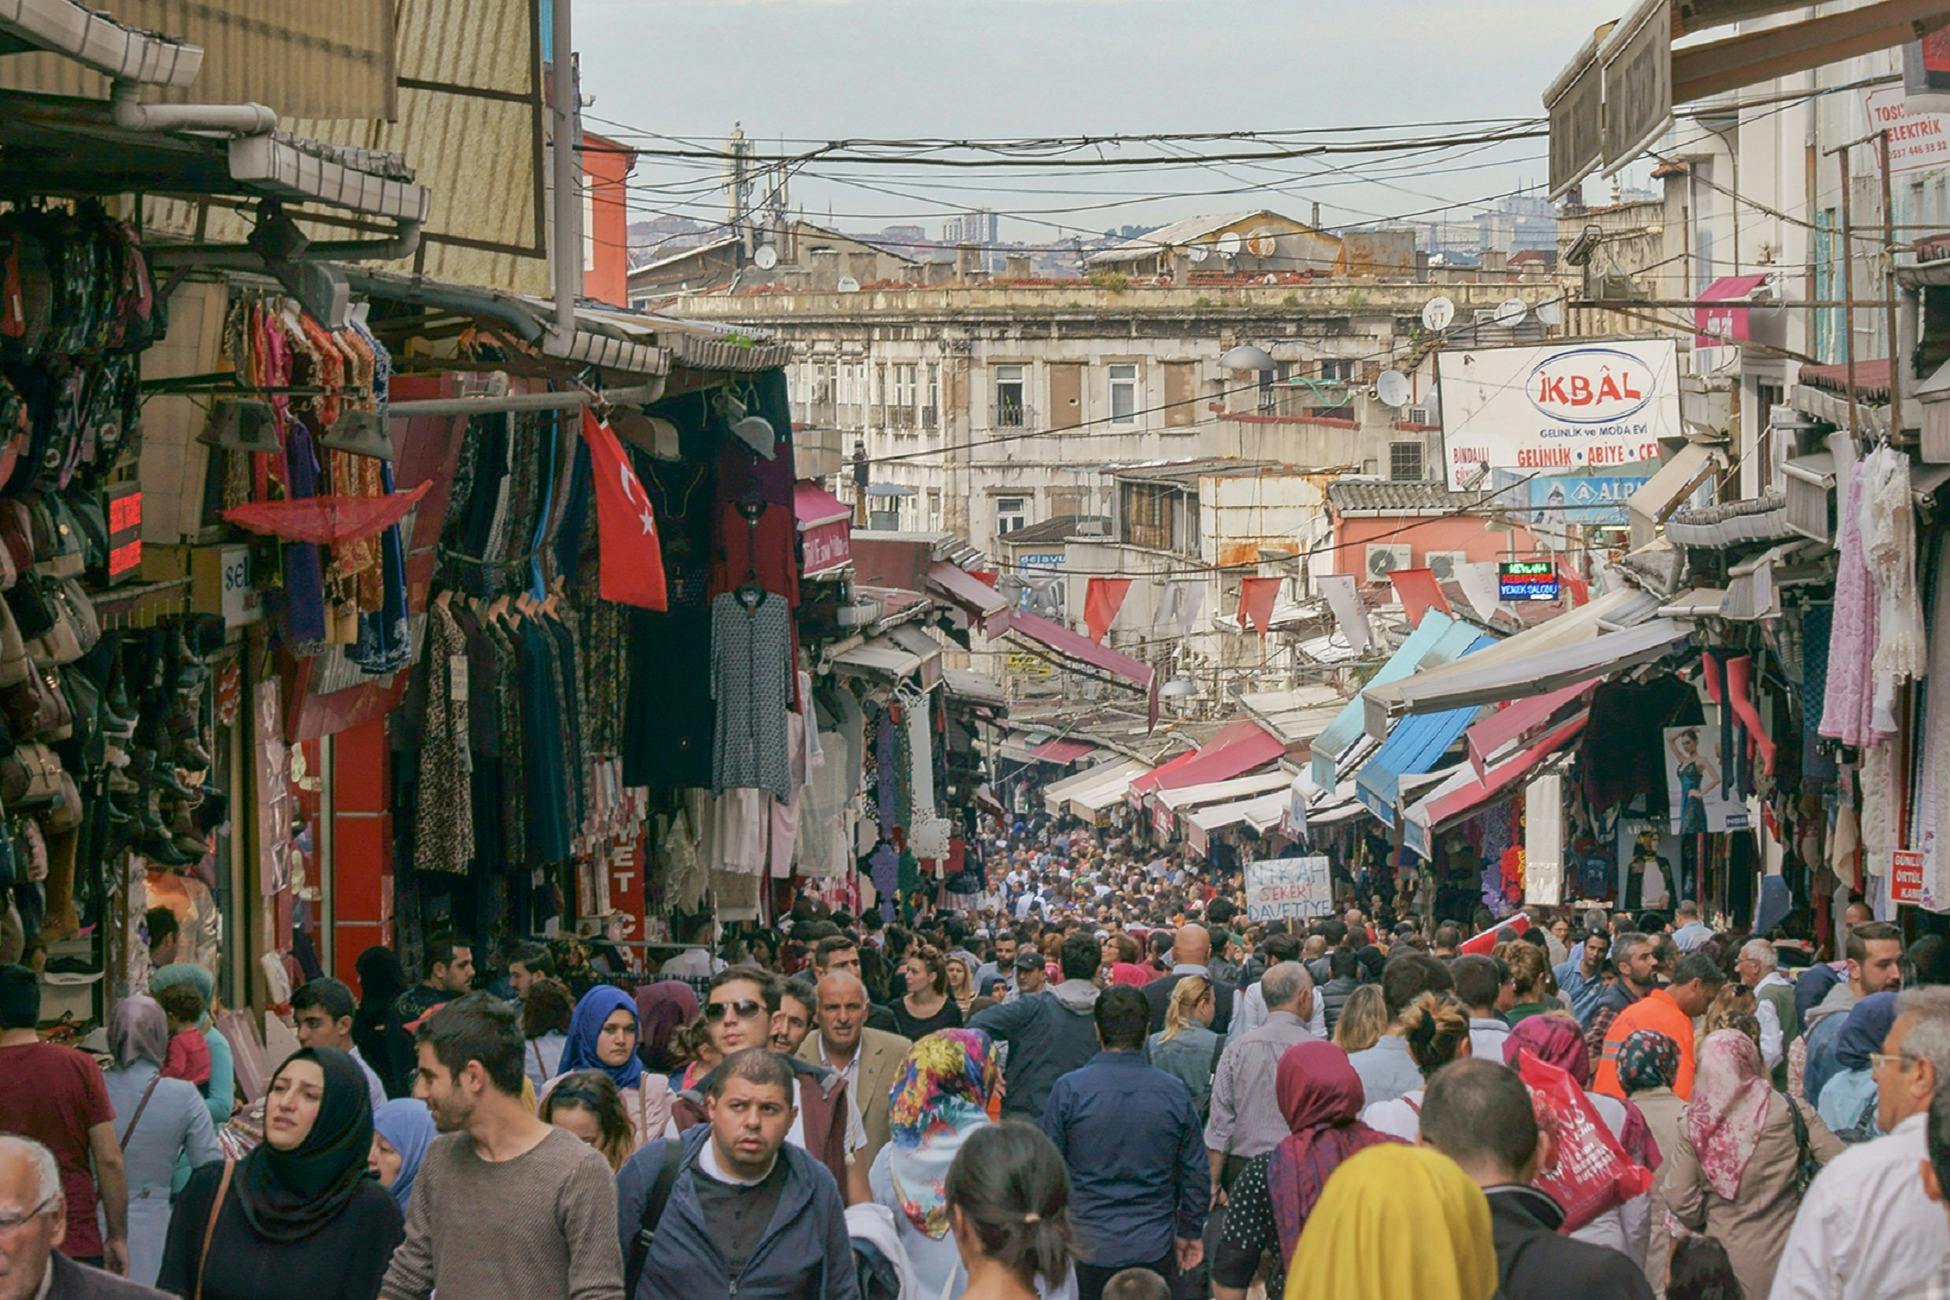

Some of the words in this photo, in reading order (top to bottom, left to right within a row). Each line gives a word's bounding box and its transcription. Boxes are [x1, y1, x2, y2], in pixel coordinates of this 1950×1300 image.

[1538, 364, 1642, 407] İKBÂL
[1600, 426, 1631, 437] MODA
[1517, 443, 1572, 467] GELİNLİK
[1587, 441, 1625, 465] ABİYE
